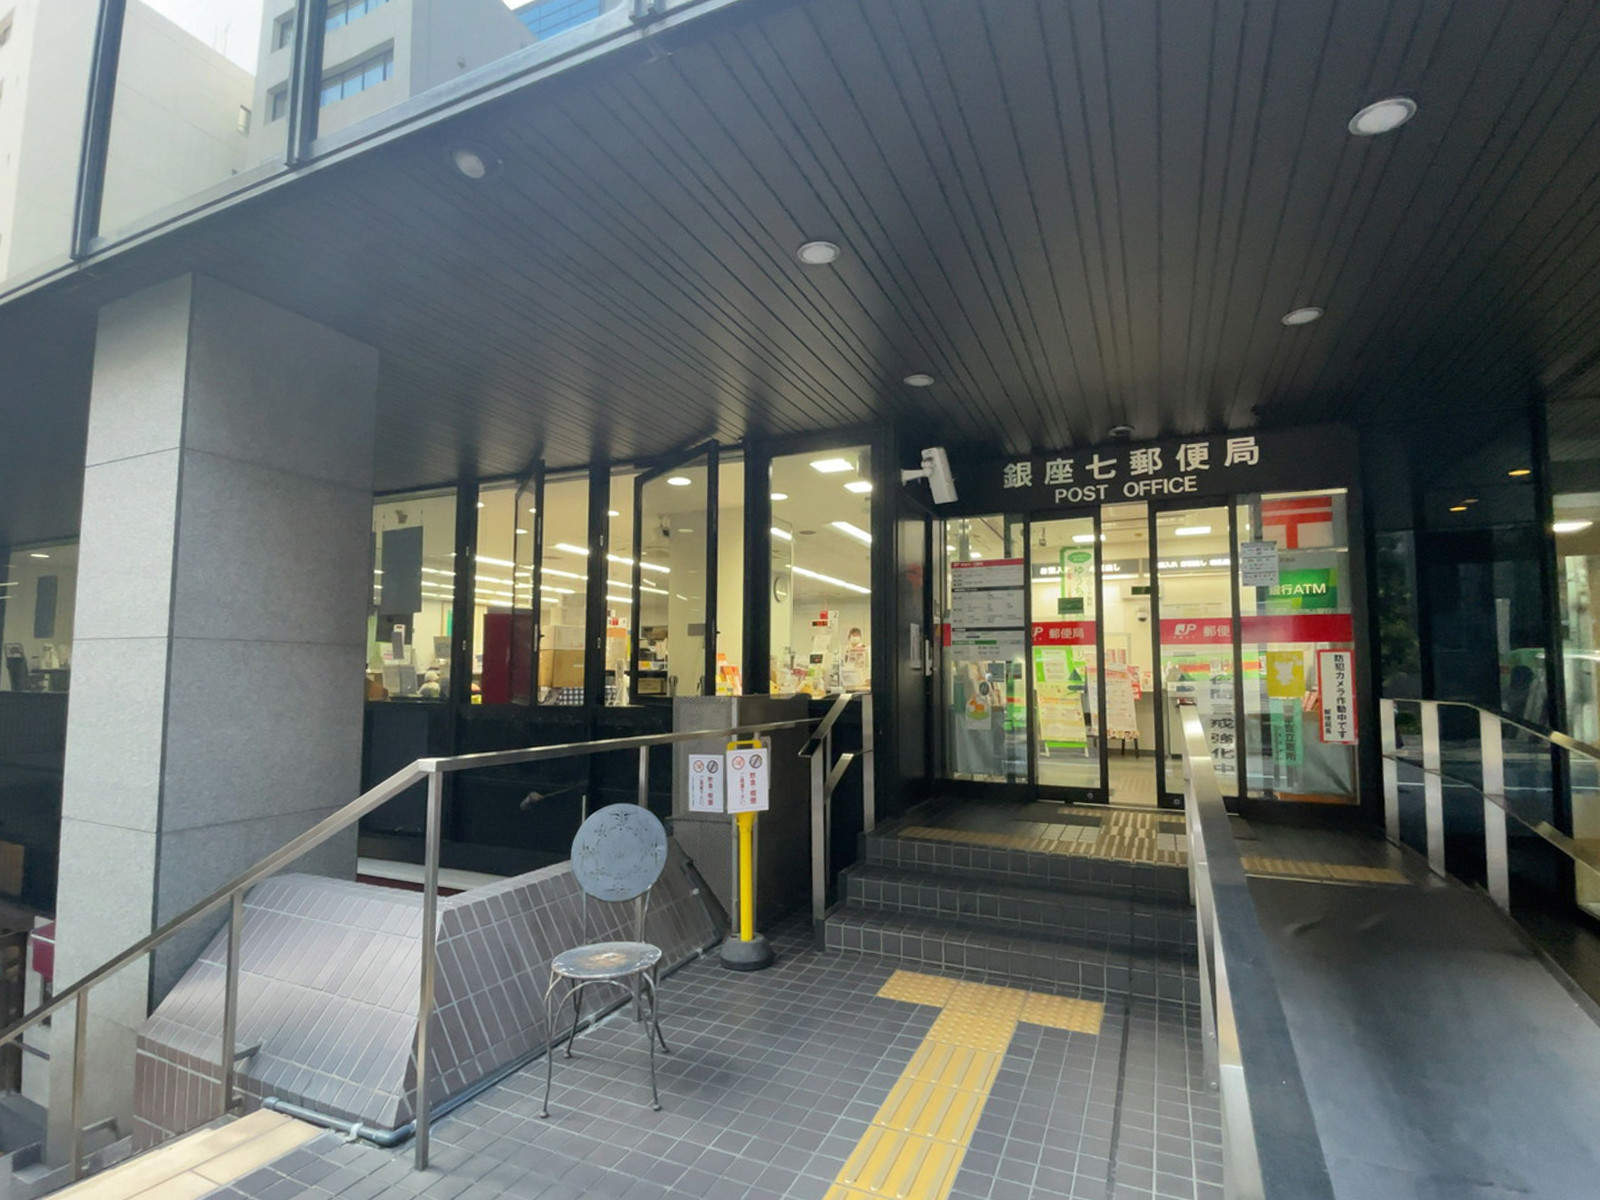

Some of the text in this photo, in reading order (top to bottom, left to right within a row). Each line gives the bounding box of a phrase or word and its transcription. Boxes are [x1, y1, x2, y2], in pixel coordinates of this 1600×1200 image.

[1003, 436, 1260, 489] 銀座七郵便局
[1055, 475, 1198, 504] POST OFFICE
[1049, 627, 1084, 640] 郵便局
[1334, 654, 1348, 739] 防犯カメラ作動中です
